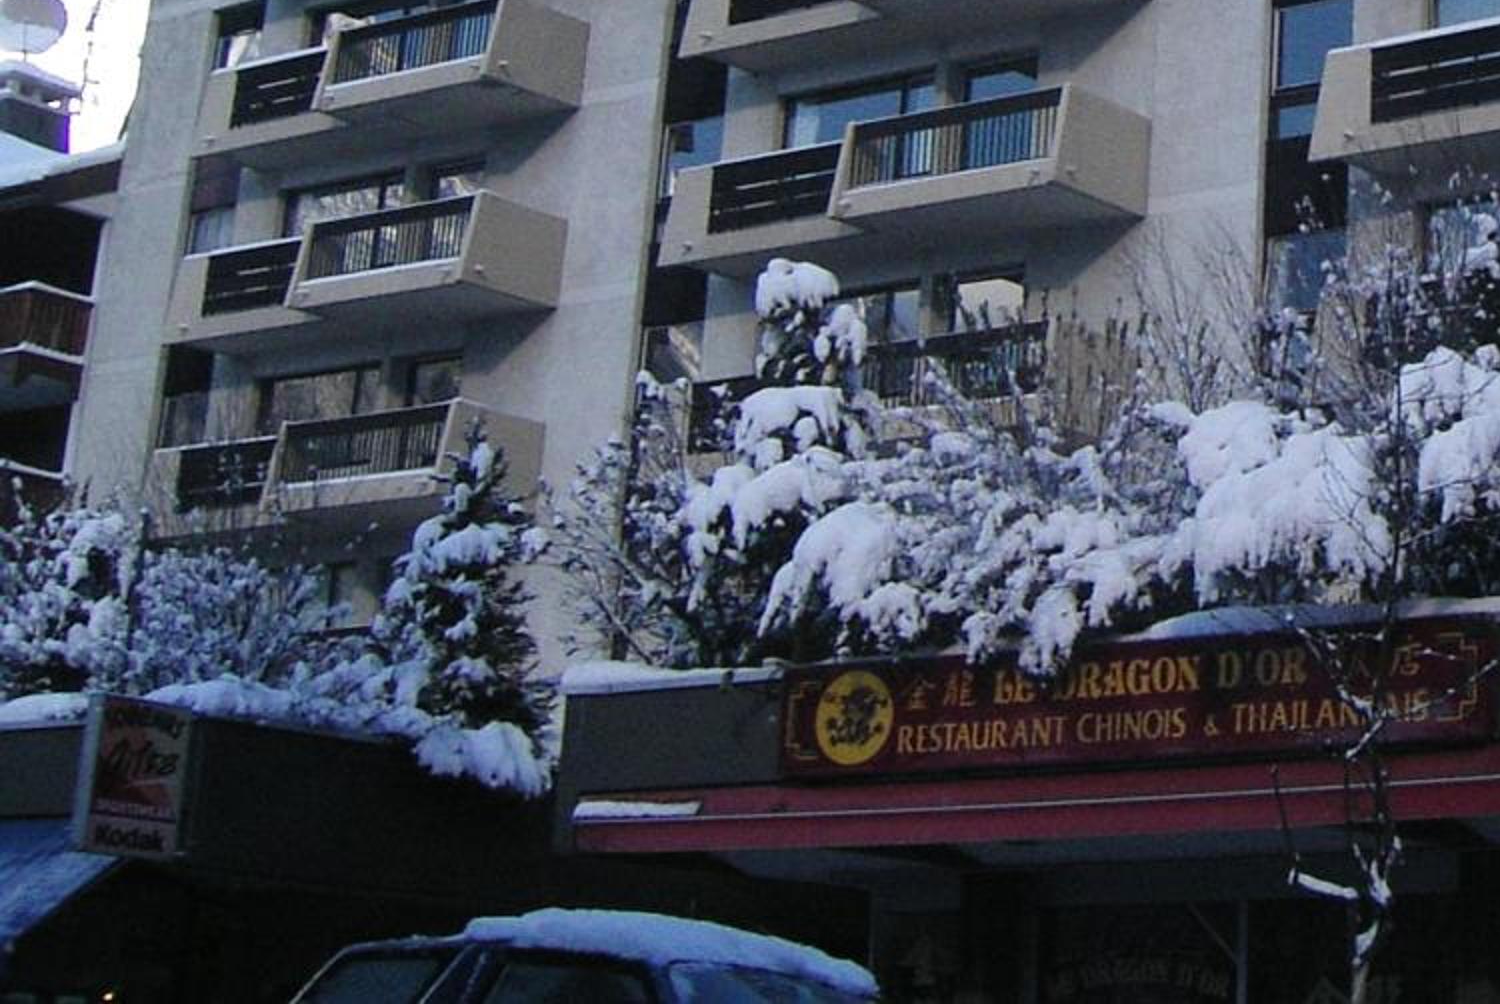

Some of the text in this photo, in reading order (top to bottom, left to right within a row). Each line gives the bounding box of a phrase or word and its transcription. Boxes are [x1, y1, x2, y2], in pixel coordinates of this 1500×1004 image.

[1216, 647, 1307, 690] D'OR
[896, 690, 1430, 755] RESTAURANT CHINOIS & THAILANAIS
[93, 824, 163, 853] Kodak
